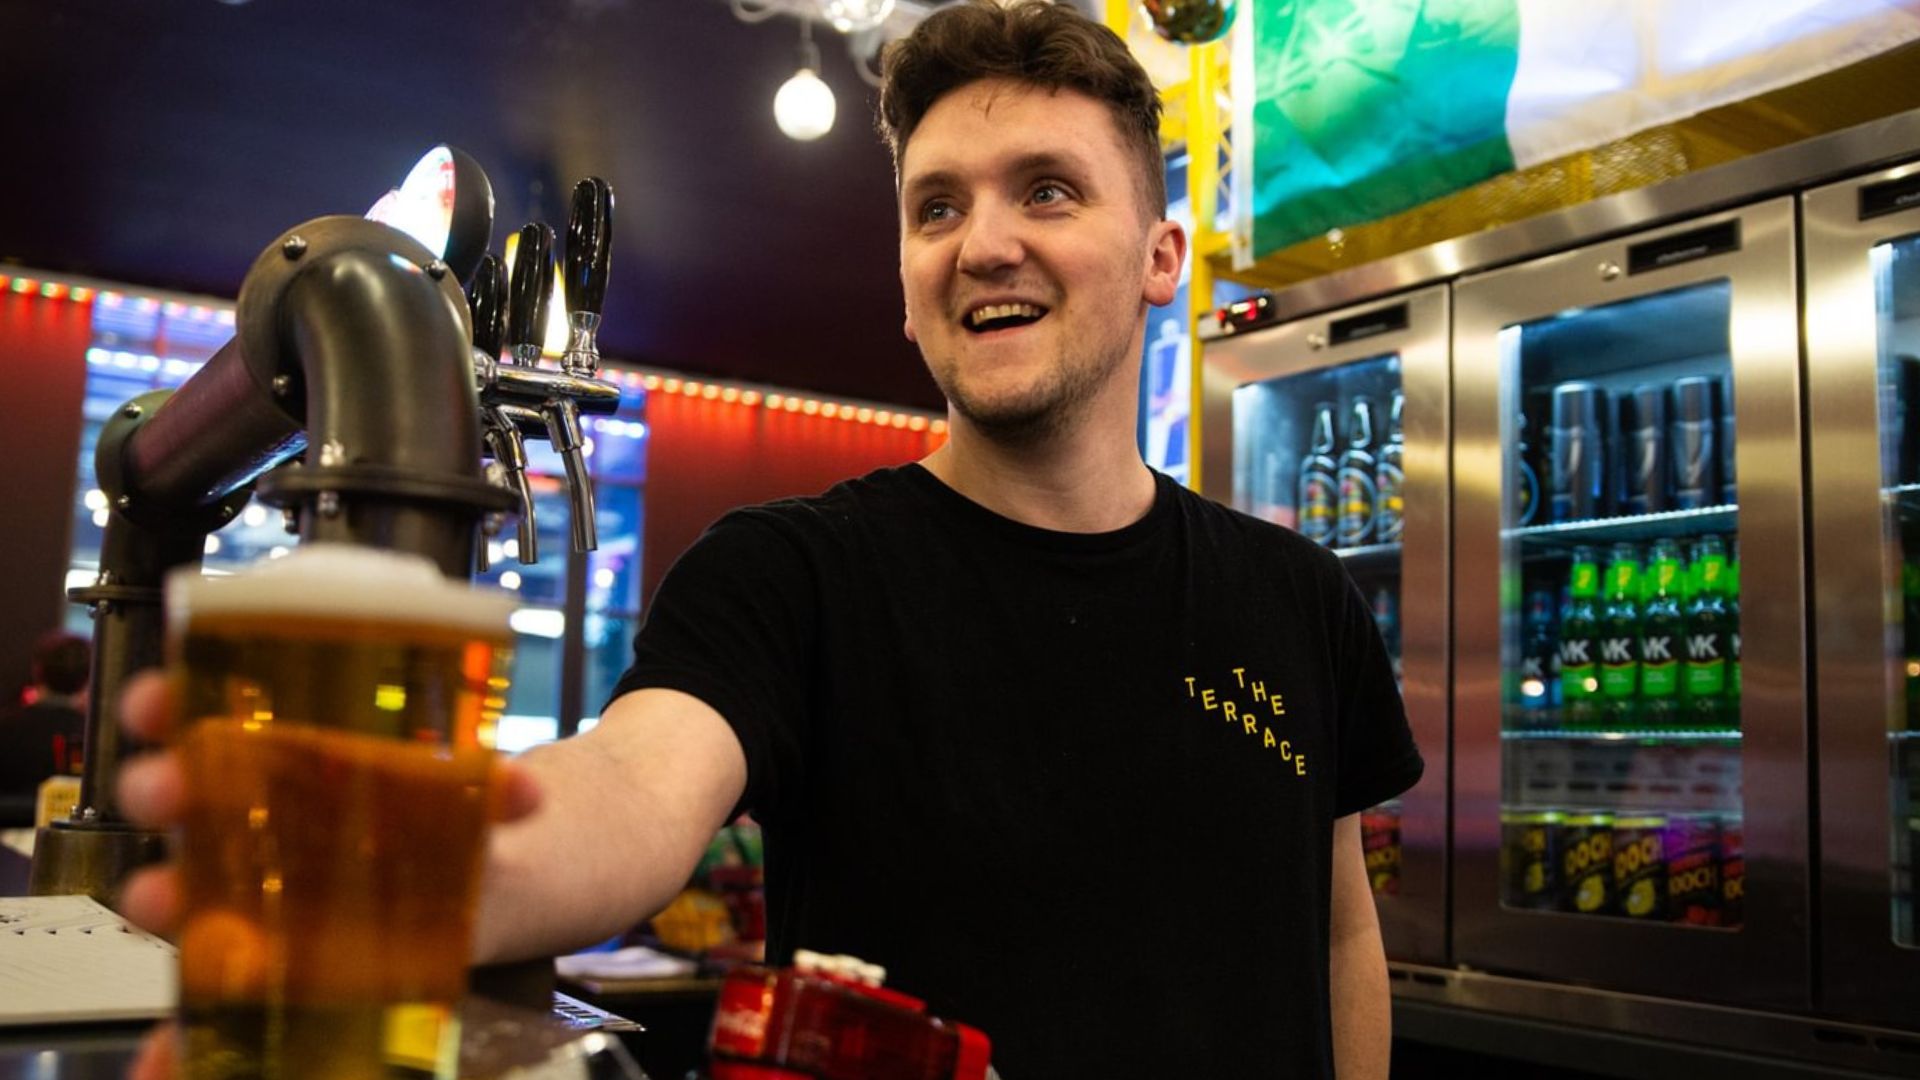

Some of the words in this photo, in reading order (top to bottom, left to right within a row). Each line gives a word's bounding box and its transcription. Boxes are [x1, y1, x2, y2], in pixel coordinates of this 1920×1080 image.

[1559, 639, 1590, 663] VK
[1600, 637, 1632, 662] VK
[1640, 635, 1672, 660] VK
[1685, 632, 1719, 659] VK
[1232, 667, 1286, 716] THE
[1184, 676, 1306, 776] TERRACE
